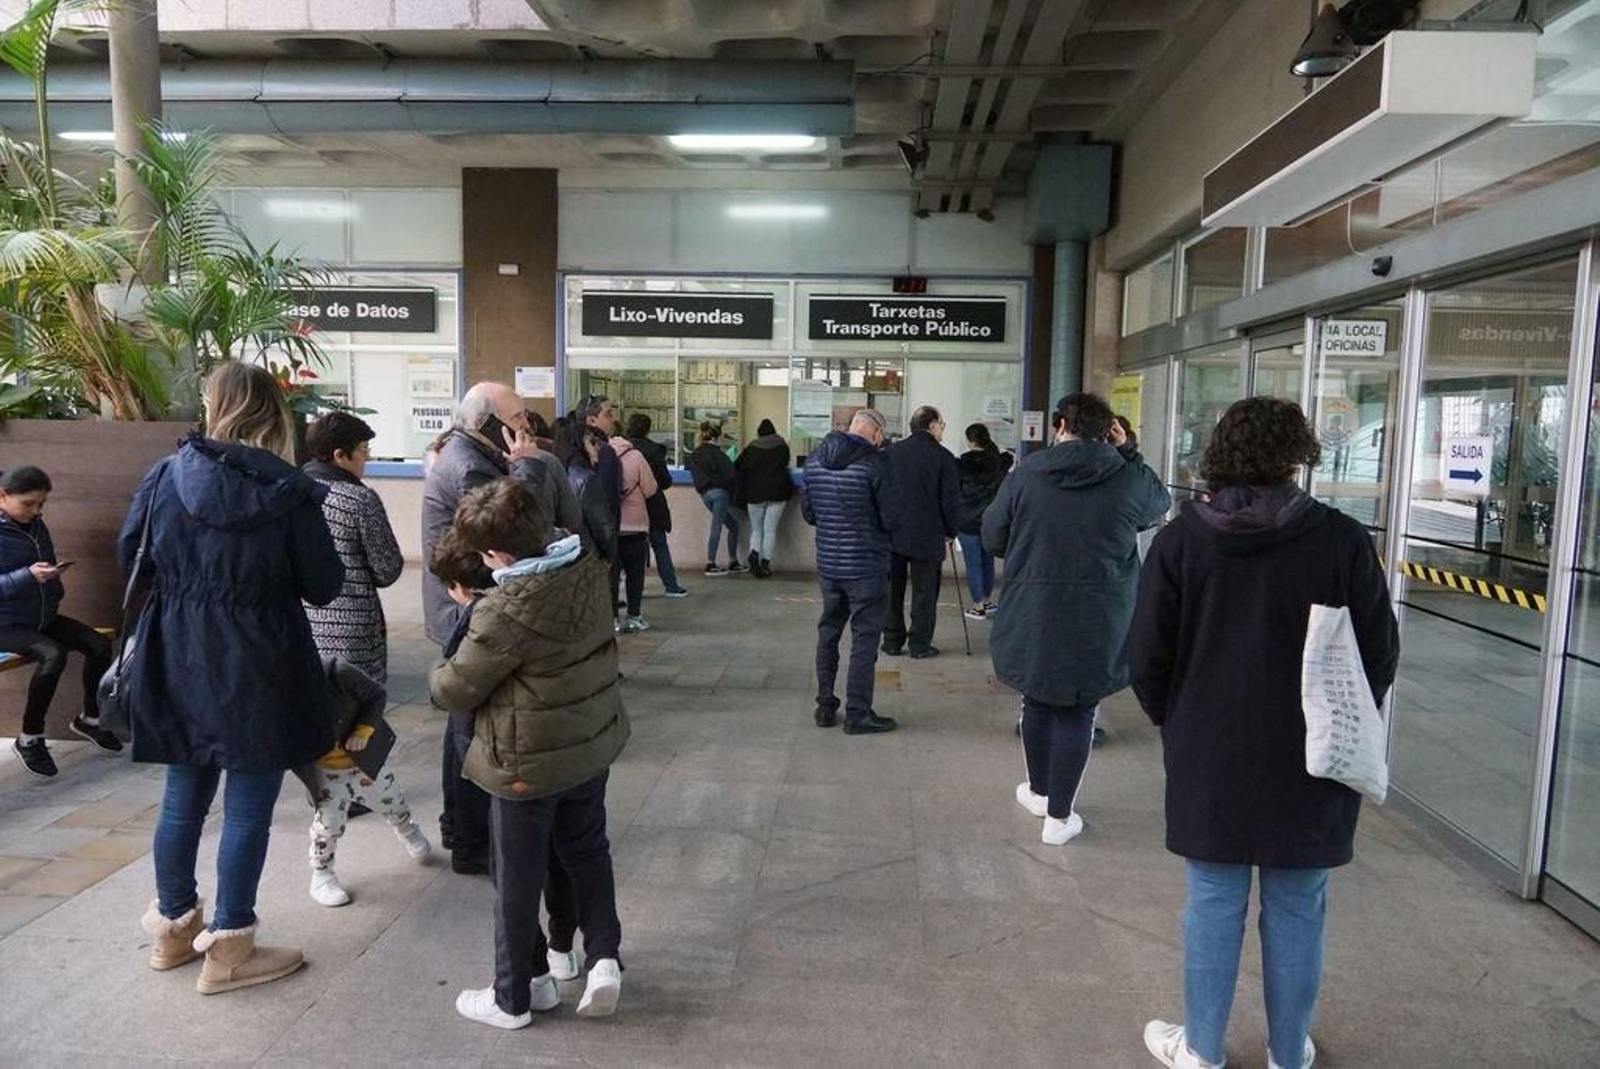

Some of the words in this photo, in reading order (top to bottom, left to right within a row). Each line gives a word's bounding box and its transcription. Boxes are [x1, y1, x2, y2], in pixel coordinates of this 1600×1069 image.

[326, 302, 350, 317] de
[356, 302, 410, 318] Datos
[609, 307, 744, 325] Lixo-Vivendas
[869, 303, 946, 319] Tarxetas
[822, 319, 920, 337] Transporte
[925, 321, 991, 337] Público
[1346, 325, 1382, 337] LOCAL
[1325, 340, 1376, 352] OFICINAS
[1451, 444, 1484, 459] SALIDA
